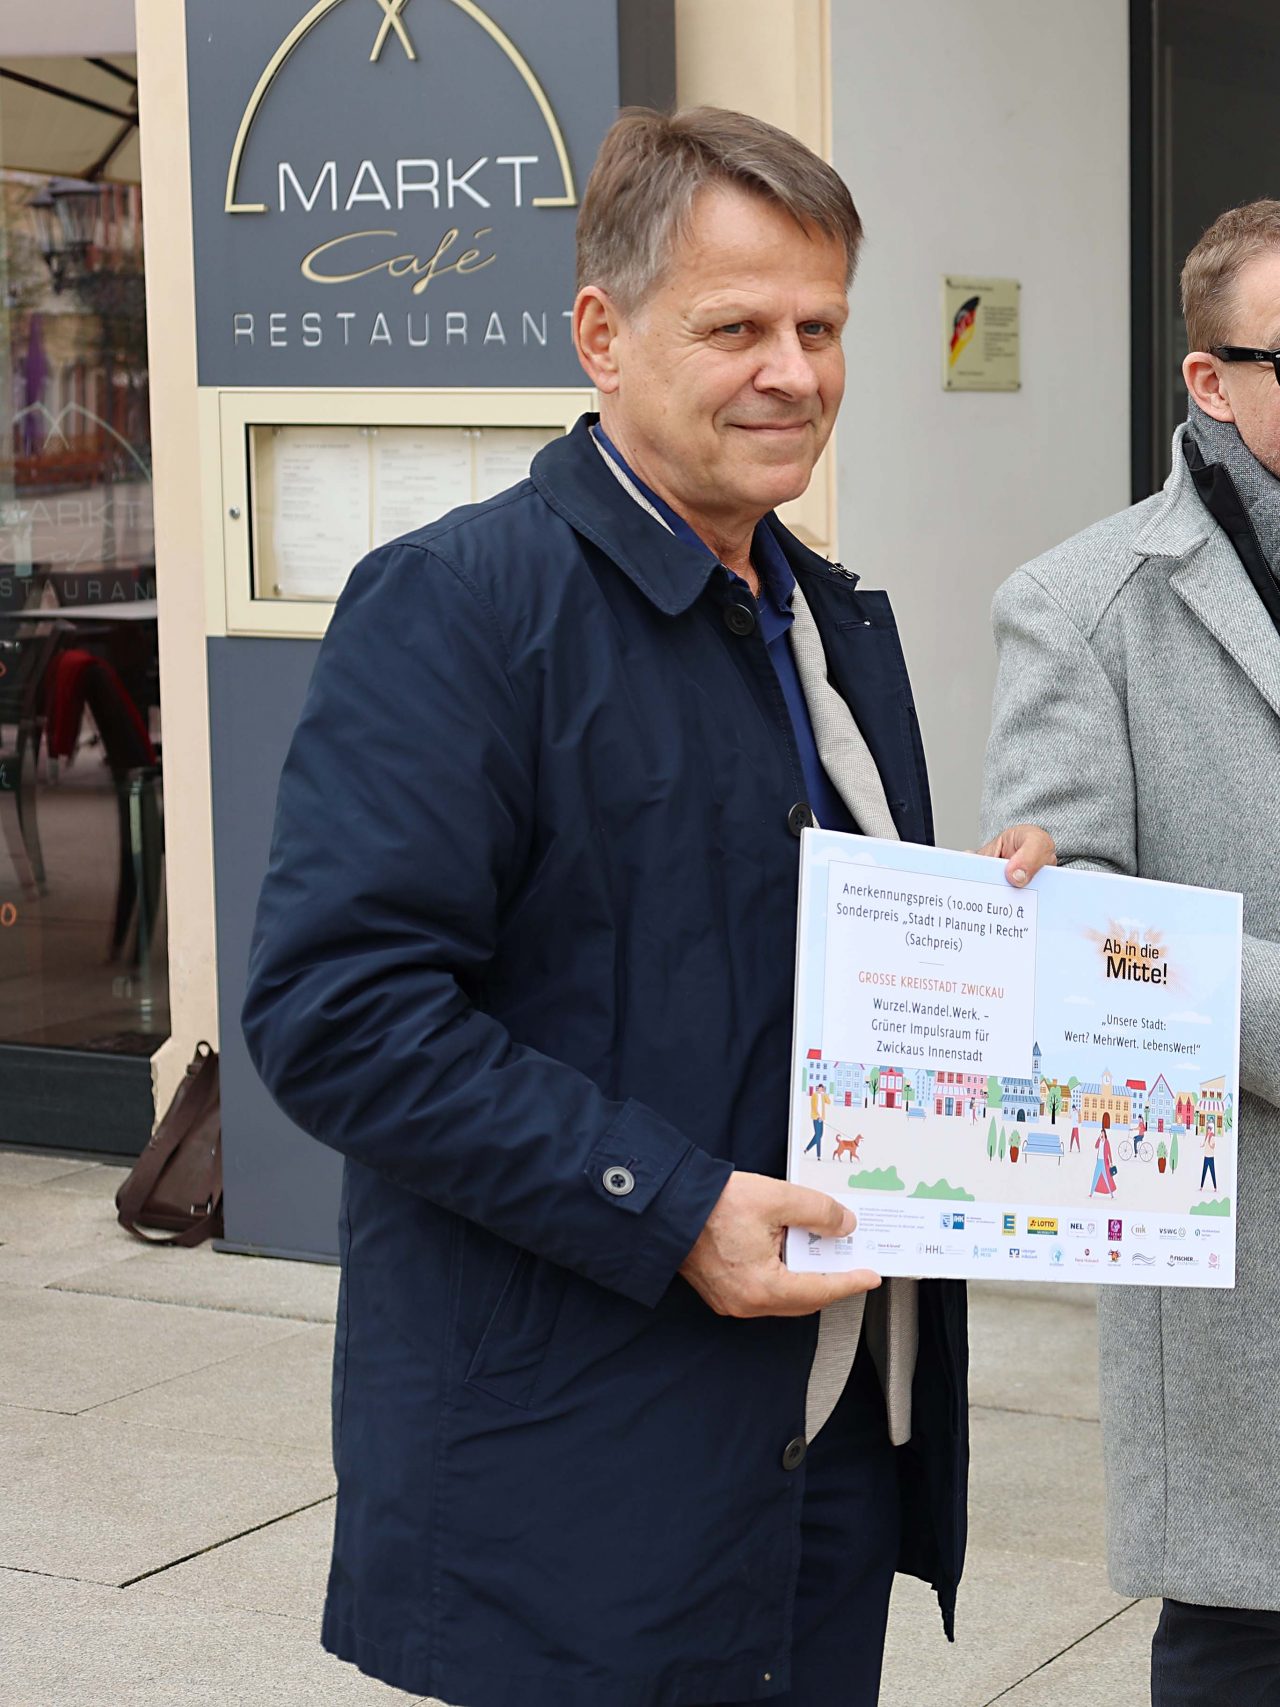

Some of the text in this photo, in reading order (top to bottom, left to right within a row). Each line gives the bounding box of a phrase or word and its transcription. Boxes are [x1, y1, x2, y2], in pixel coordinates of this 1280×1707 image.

[278, 156, 539, 212] MARKT
[300, 228, 496, 295] Café
[0, 578, 152, 600] STAURAN
[843, 883, 1024, 918] Anerkennungspreis (10.000 Euro) &
[836, 903, 899, 922] Sonderpreis
[902, 913, 934, 927] „Stadt
[945, 918, 986, 937] Planung
[905, 931, 963, 952] (Sachpreis)
[1103, 938, 1159, 960] Ab in die
[1106, 956, 1168, 985] Mitte!
[858, 971, 1004, 999] GROSSE KREISSTADT ZWICKAU
[873, 998, 980, 1021] Wurzel.Wandel.Werk.
[871, 1019, 990, 1042] Grüner Impulsraum für
[1101, 1014, 1166, 1031] „Unsere Stadt:
[876, 1040, 983, 1062] Zwickaus Innenstadt
[1064, 1031, 1089, 1044] Wert?
[1093, 1034, 1139, 1049] MehrWert.
[1037, 1220, 1055, 1228] LOTTO
[1070, 1222, 1085, 1230] NEL
[925, 1244, 944, 1255] HHL
